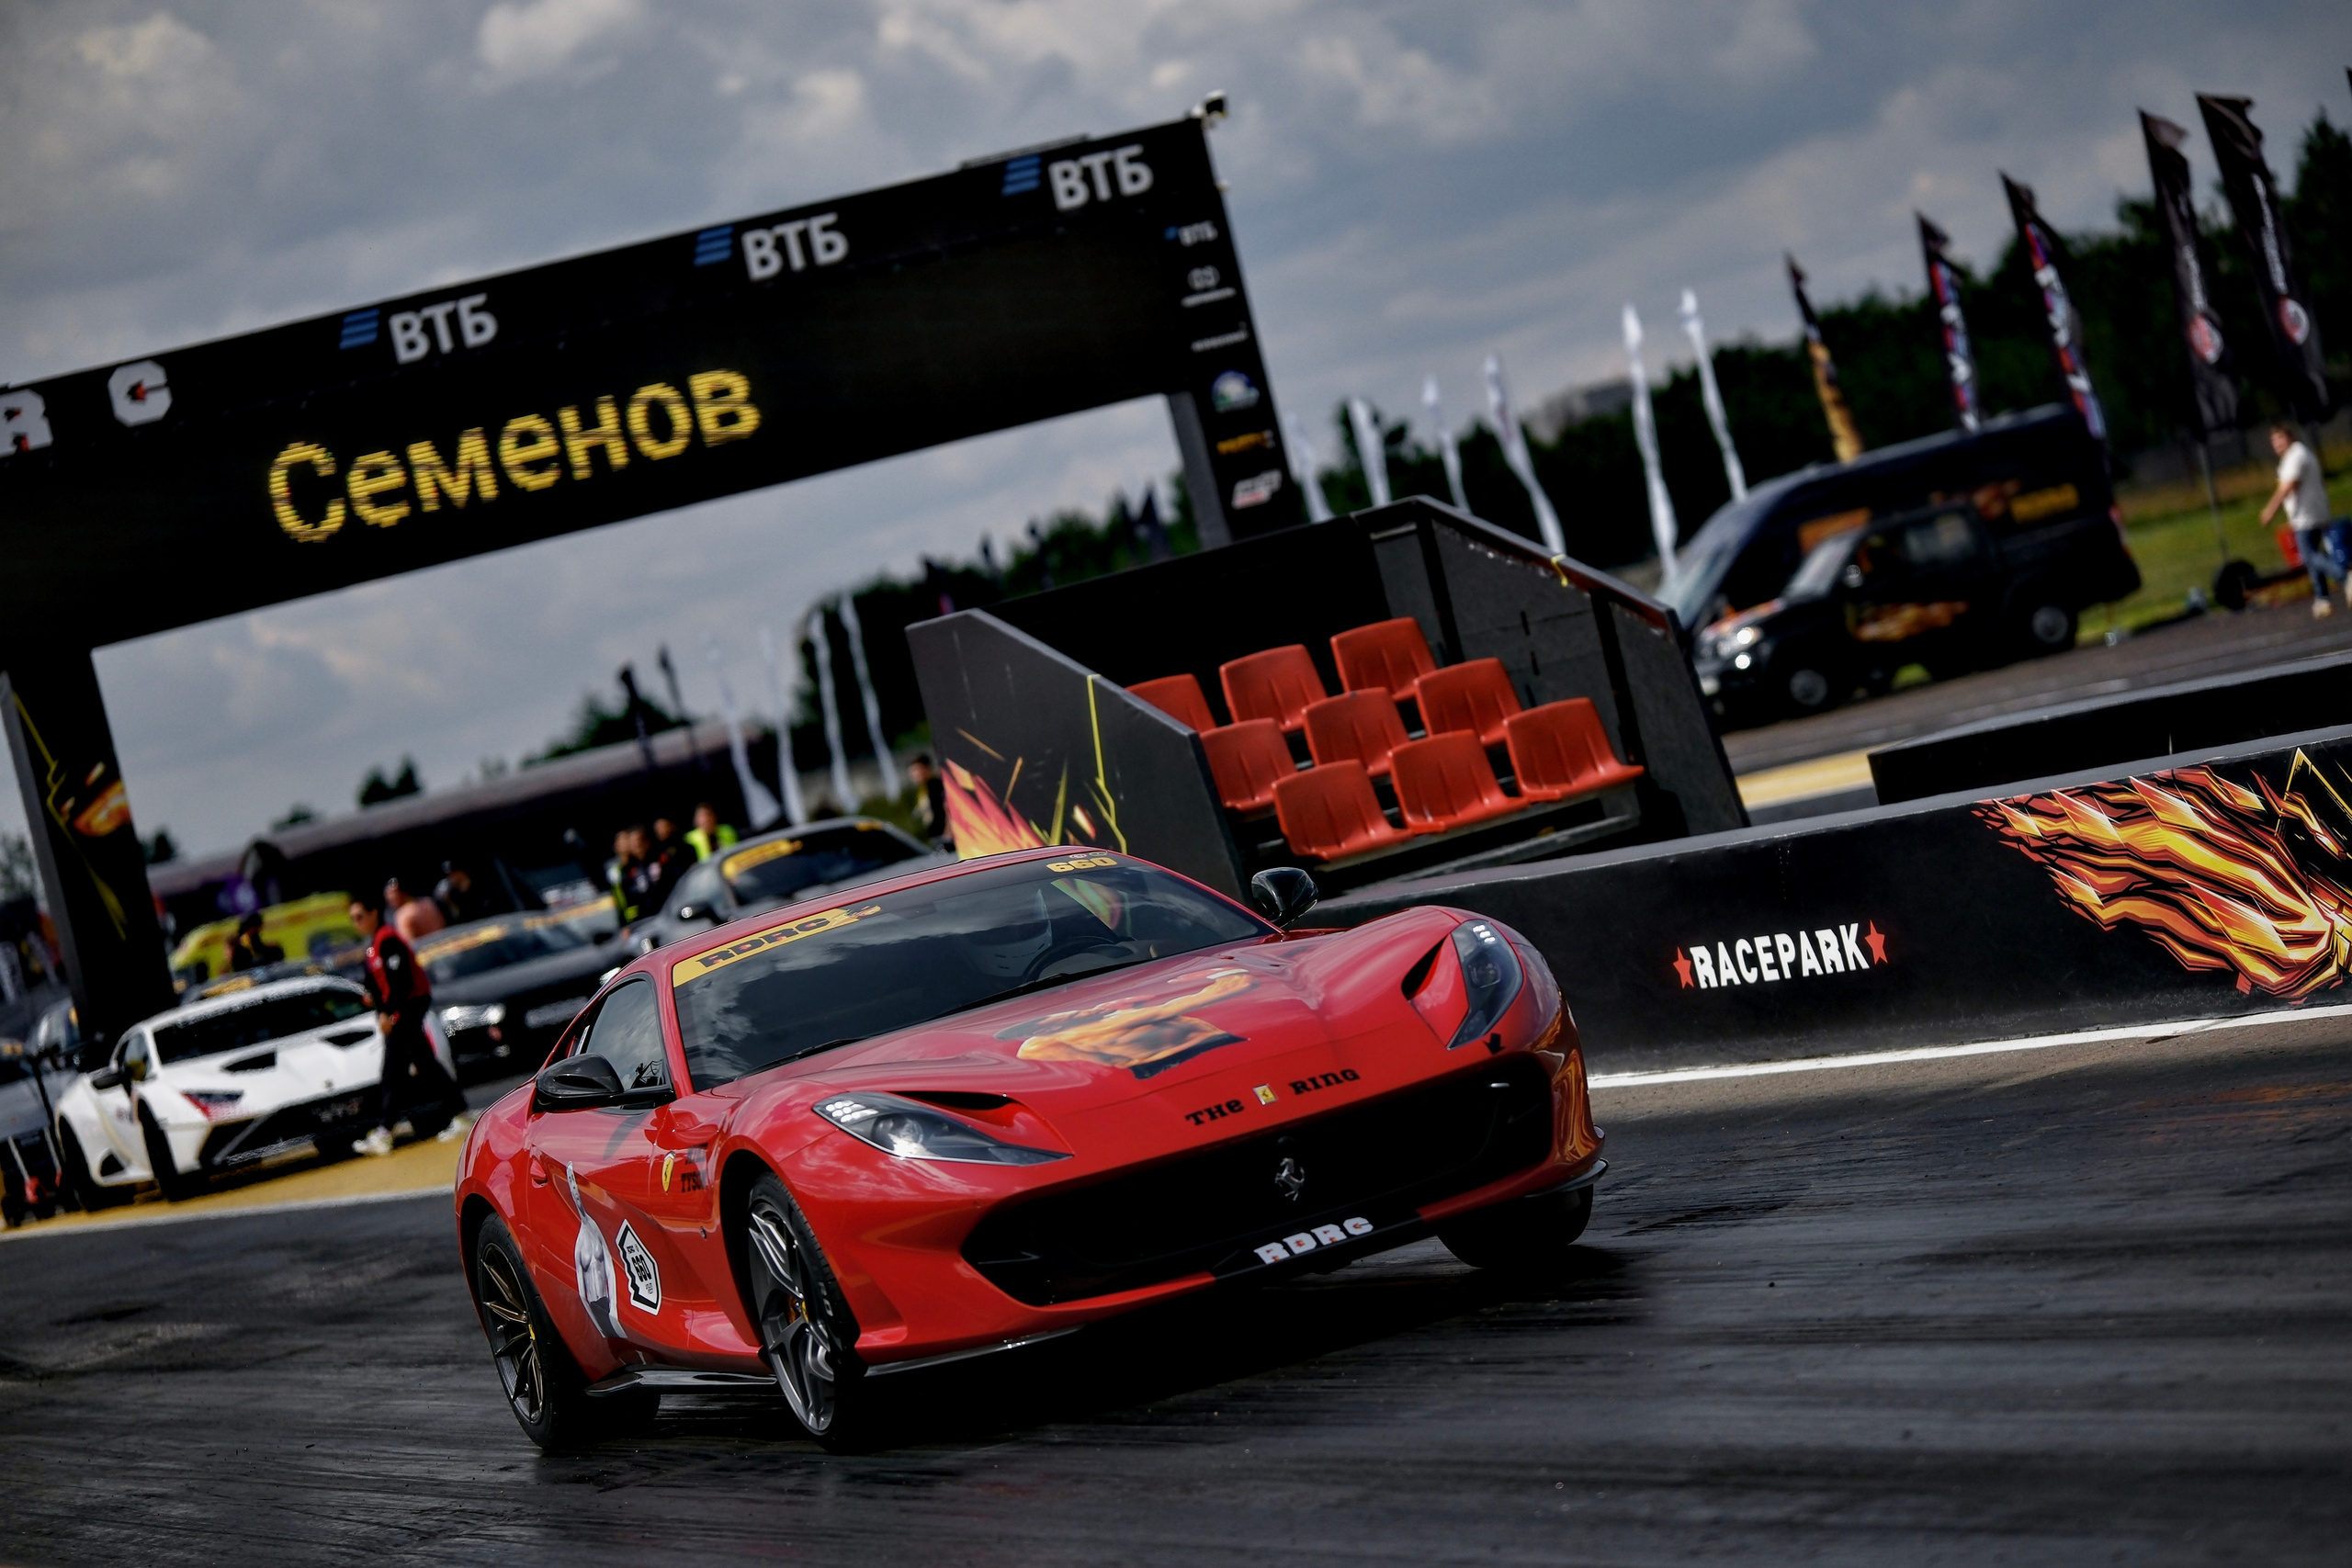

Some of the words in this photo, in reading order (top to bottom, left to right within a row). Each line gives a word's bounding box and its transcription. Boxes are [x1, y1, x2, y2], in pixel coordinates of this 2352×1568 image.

[1048, 145, 1153, 210] ВТБ
[741, 213, 848, 281] ВТБ
[389, 293, 498, 364] ВТБ
[268, 369, 763, 542] Семенов
[1046, 857, 1117, 873] 660
[696, 918, 830, 967] RDRC
[1690, 923, 1870, 989] RACEPARK
[1253, 1217, 1374, 1265] RDRC
